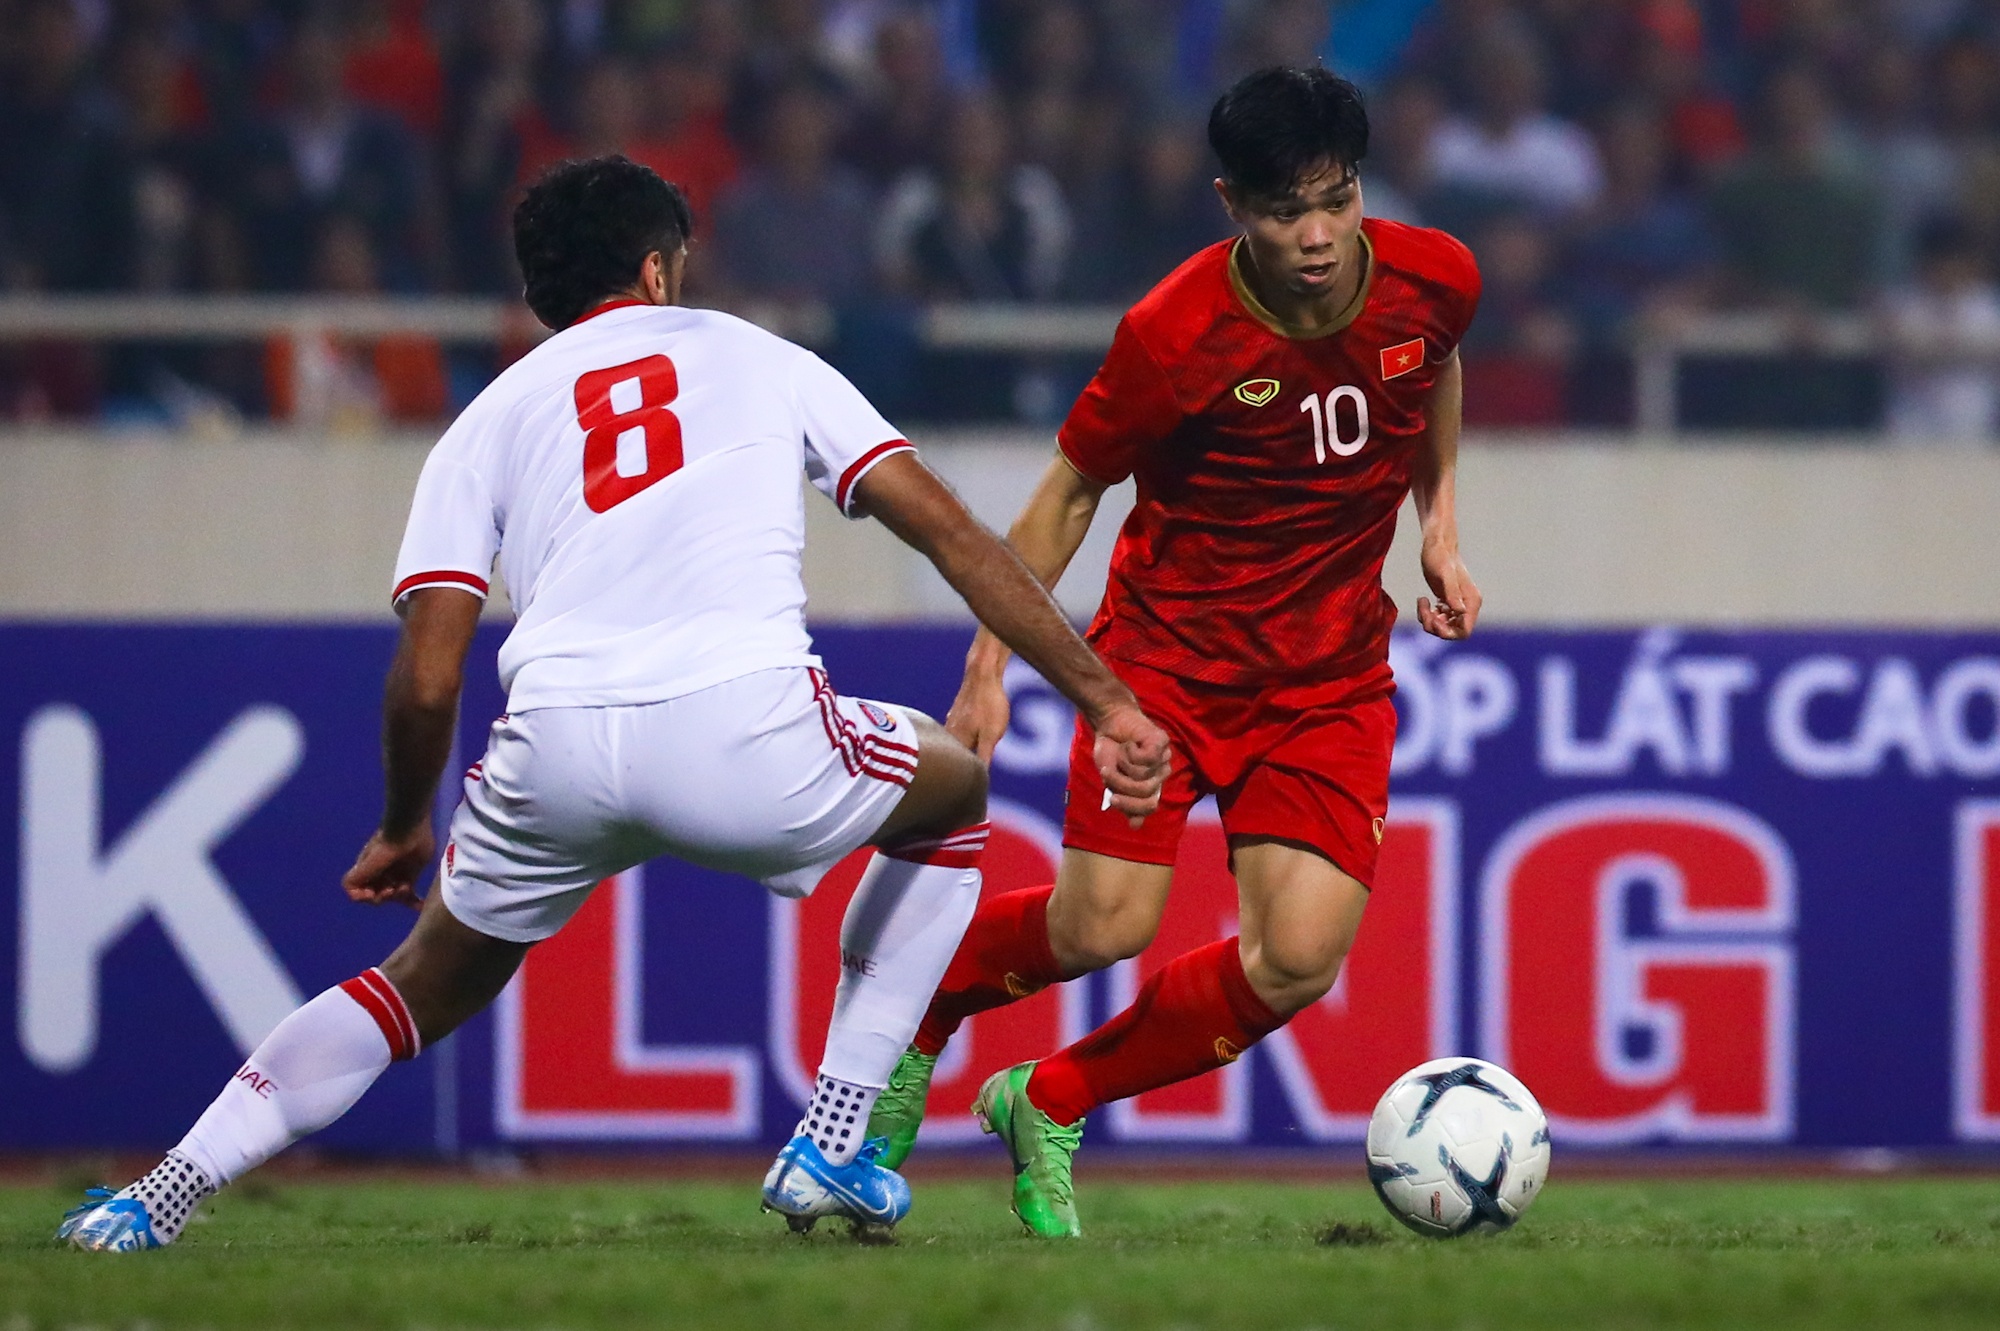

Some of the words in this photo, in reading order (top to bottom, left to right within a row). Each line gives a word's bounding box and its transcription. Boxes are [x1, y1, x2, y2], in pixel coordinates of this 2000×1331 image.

[574, 353, 684, 514] 8
[1300, 385, 1369, 465] 10
[1538, 627, 1758, 778] LÁT
[1767, 655, 2000, 779] CAO
